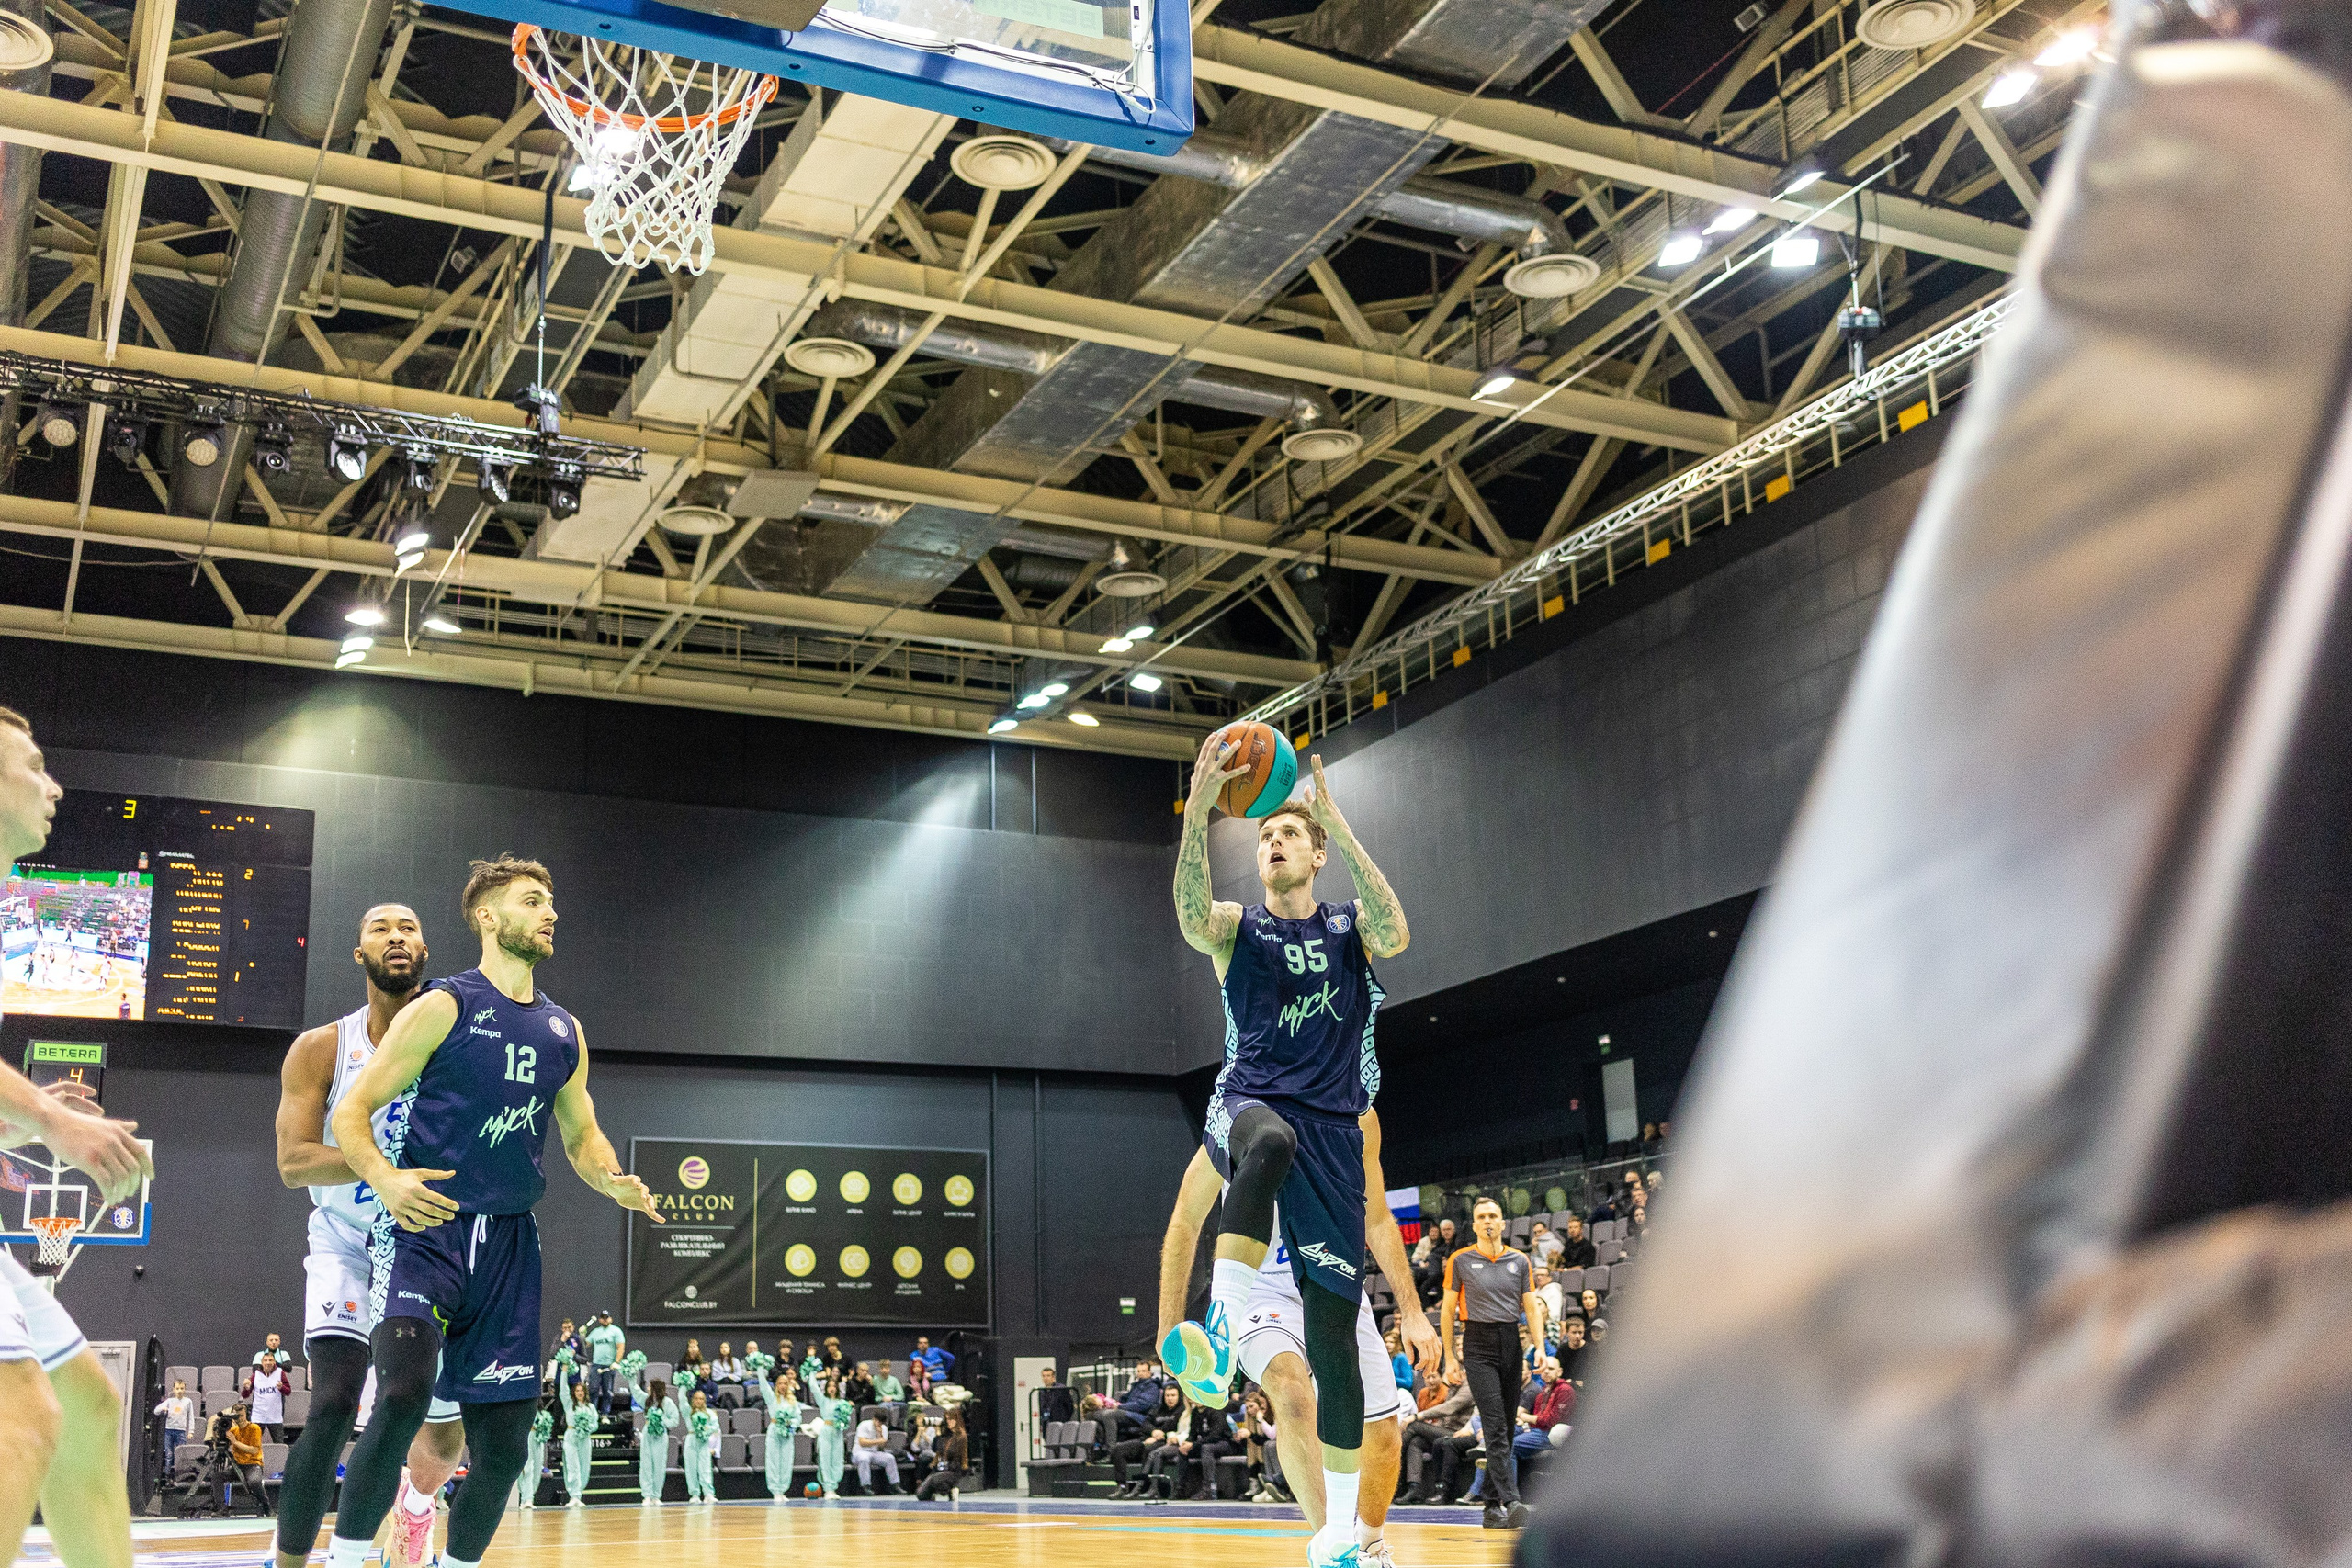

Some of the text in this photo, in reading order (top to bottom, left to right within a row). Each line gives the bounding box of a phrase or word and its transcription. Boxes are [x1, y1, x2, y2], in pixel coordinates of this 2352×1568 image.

[123, 799, 137, 819] 3
[1284, 938, 1329, 975] 95
[469, 1025, 502, 1039] Kempa
[39, 1047, 97, 1058] BET.ERA
[504, 1043, 537, 1084] 12
[69, 1067, 84, 1084] 4
[653, 1194, 735, 1211] FALCON
[672, 1213, 715, 1221] CLUB
[337, 1314, 357, 1323] ENISEY
